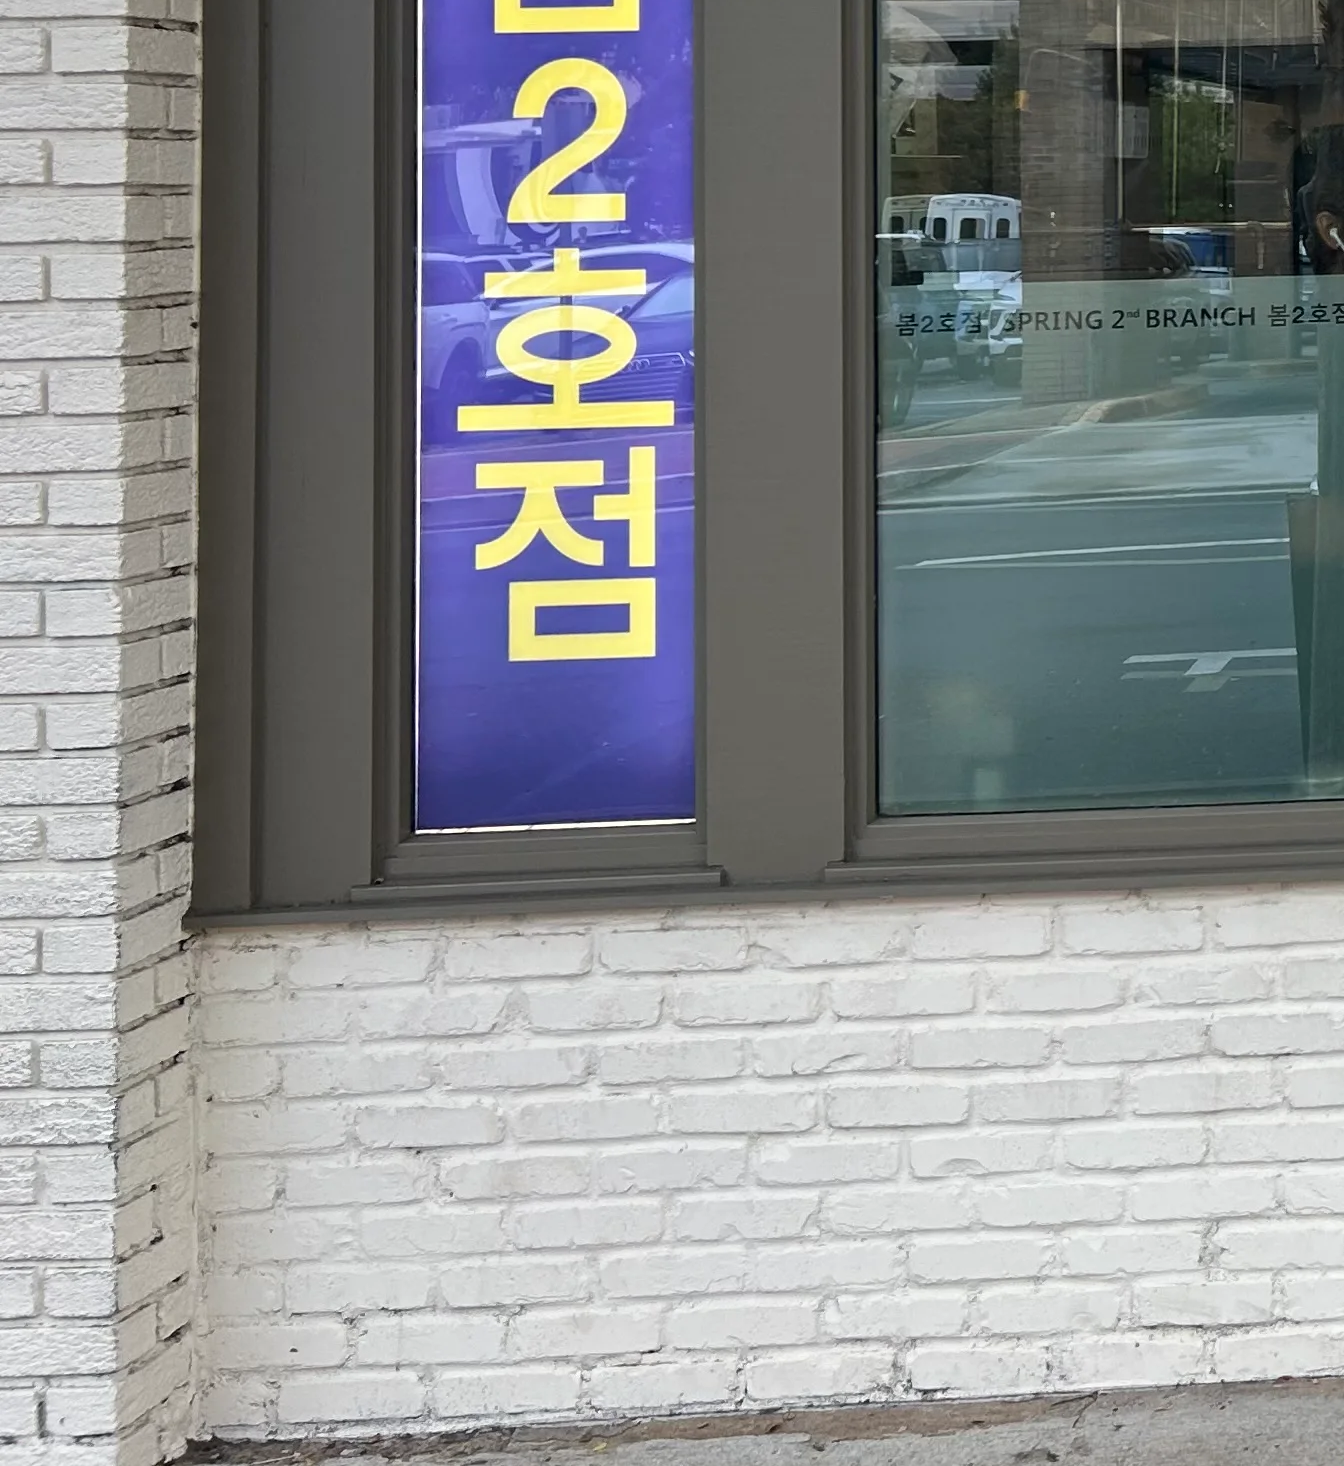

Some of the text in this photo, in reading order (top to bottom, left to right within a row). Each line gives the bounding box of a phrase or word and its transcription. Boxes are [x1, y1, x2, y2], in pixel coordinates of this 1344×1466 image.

[895, 313, 982, 337] 봄2호점
[1001, 310, 1104, 333] SPRING
[1146, 306, 1257, 329] BRANCH
